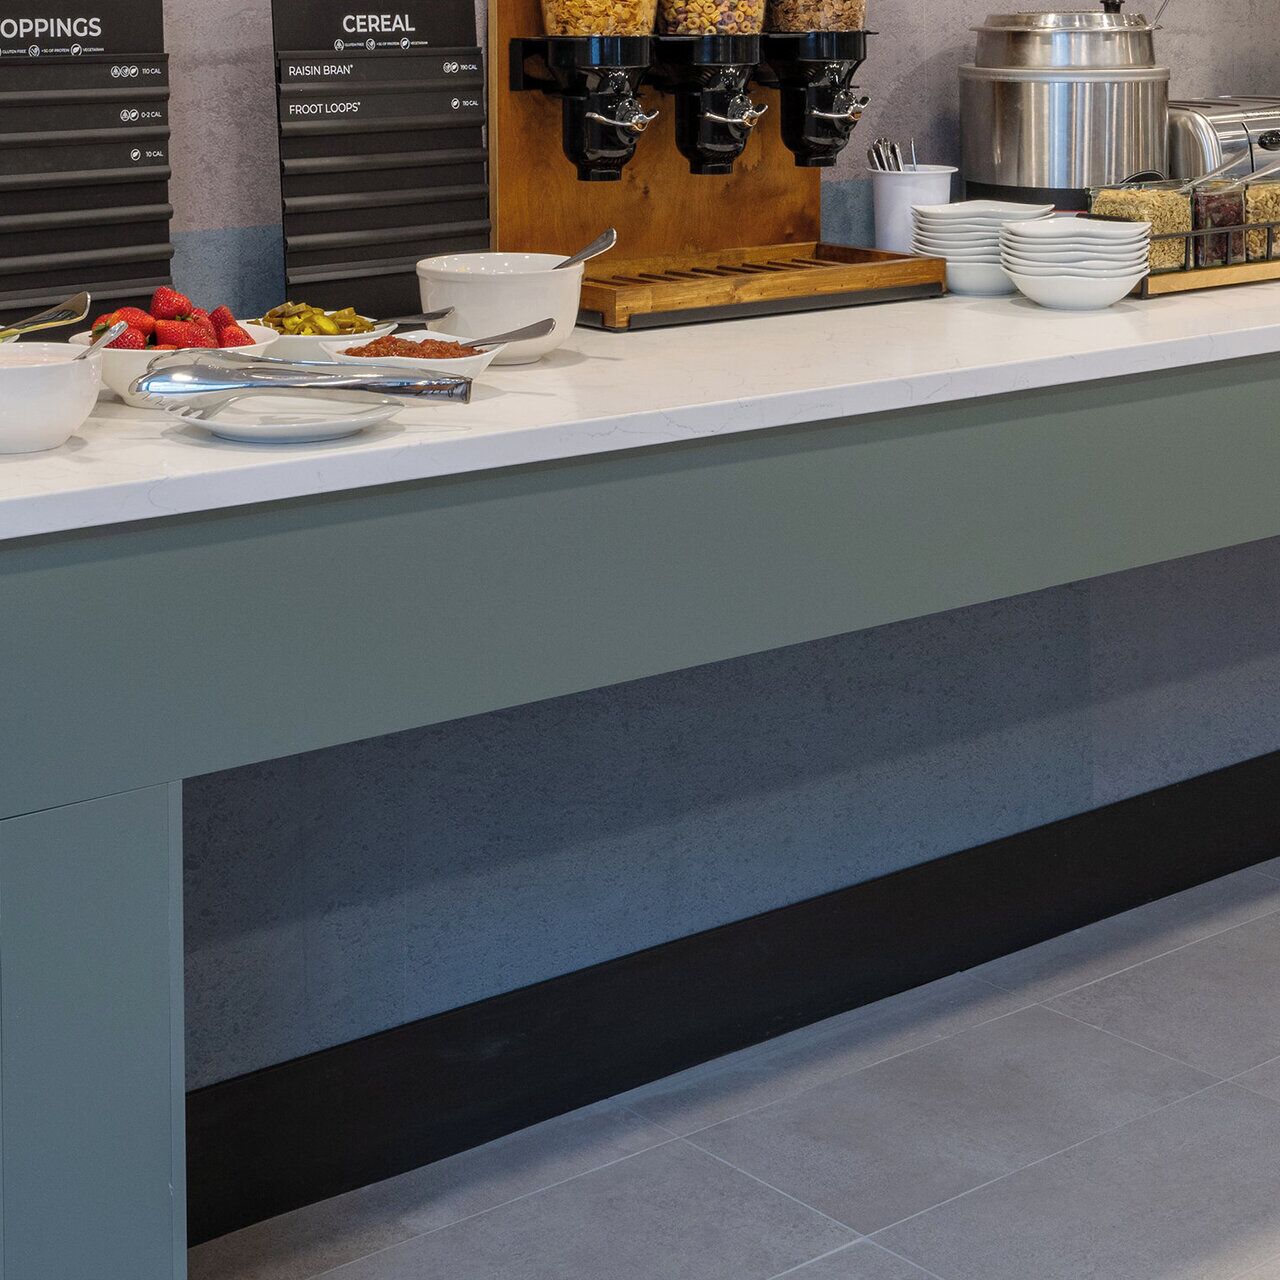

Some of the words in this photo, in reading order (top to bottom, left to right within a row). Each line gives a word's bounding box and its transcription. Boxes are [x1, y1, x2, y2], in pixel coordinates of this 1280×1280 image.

[343, 15, 415, 32] CEREAL
[289, 66, 320, 75] RAISIN
[290, 104, 323, 114] FROOT
